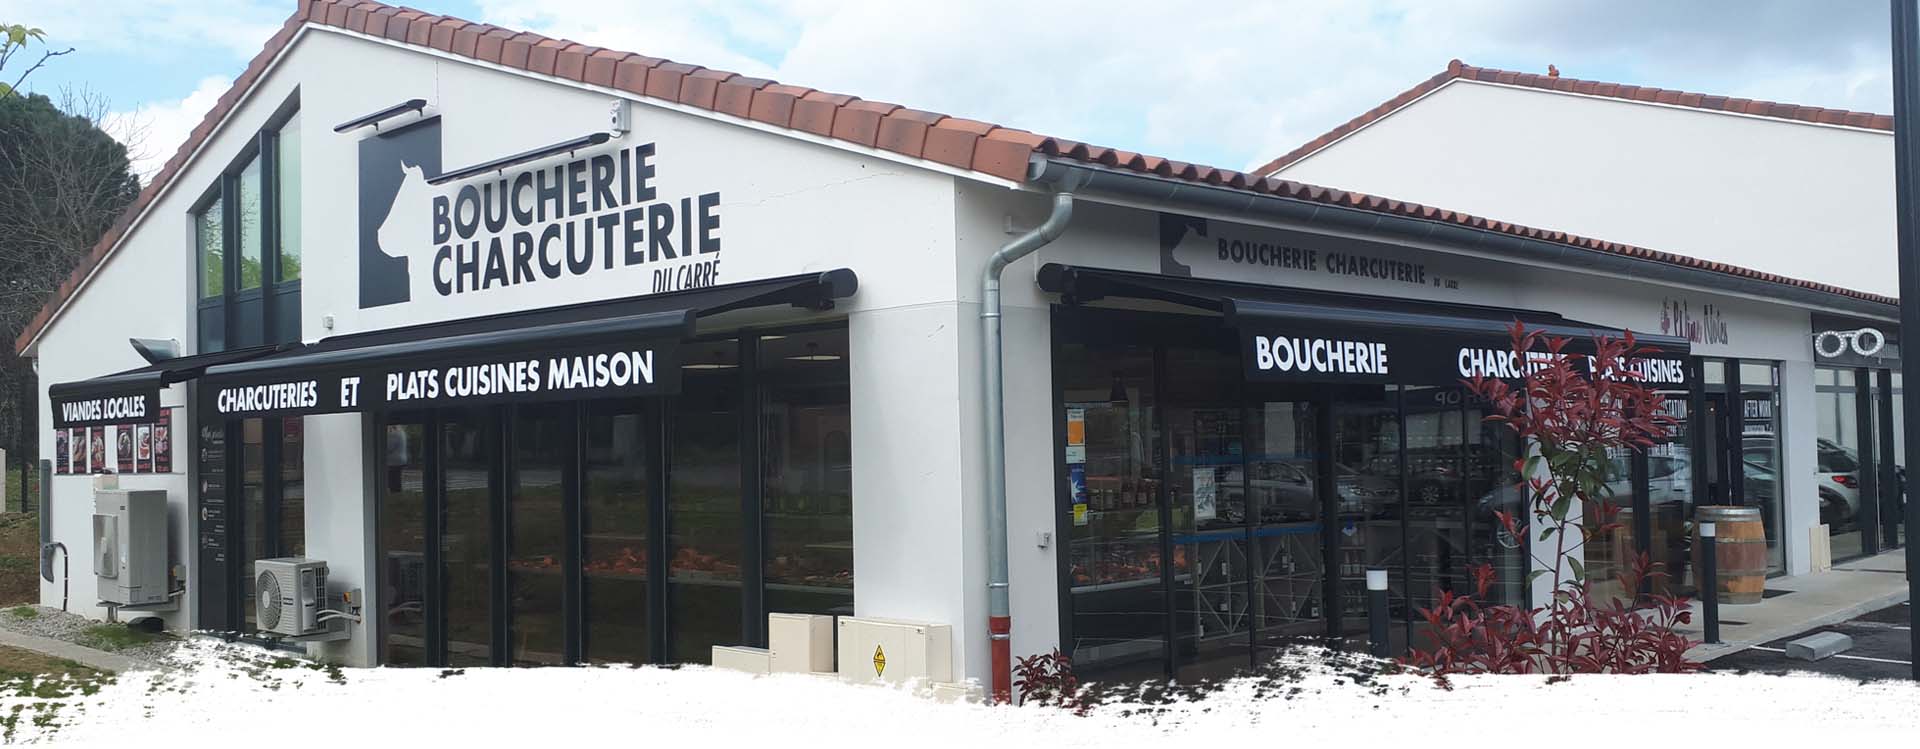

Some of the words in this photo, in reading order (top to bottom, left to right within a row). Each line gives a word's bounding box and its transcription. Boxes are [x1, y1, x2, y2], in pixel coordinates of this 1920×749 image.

[433, 142, 656, 245] BOUCHERIE
[433, 191, 720, 296] CHARCUTERIE
[1218, 238, 1318, 272] BOUCHERIE
[1326, 252, 1426, 285] CHARCUTERIE
[652, 266, 673, 293] DU
[676, 251, 721, 290] CARRÉ
[1256, 335, 1389, 375] BOUCHERIE
[217, 380, 318, 413] CHARCUTERIES
[340, 376, 361, 407] ET
[386, 369, 439, 401] PLATS
[444, 360, 541, 398] CUISINES
[547, 350, 654, 390] MAISON
[62, 399, 102, 422] VIANDES
[103, 395, 146, 419] LOCALES
